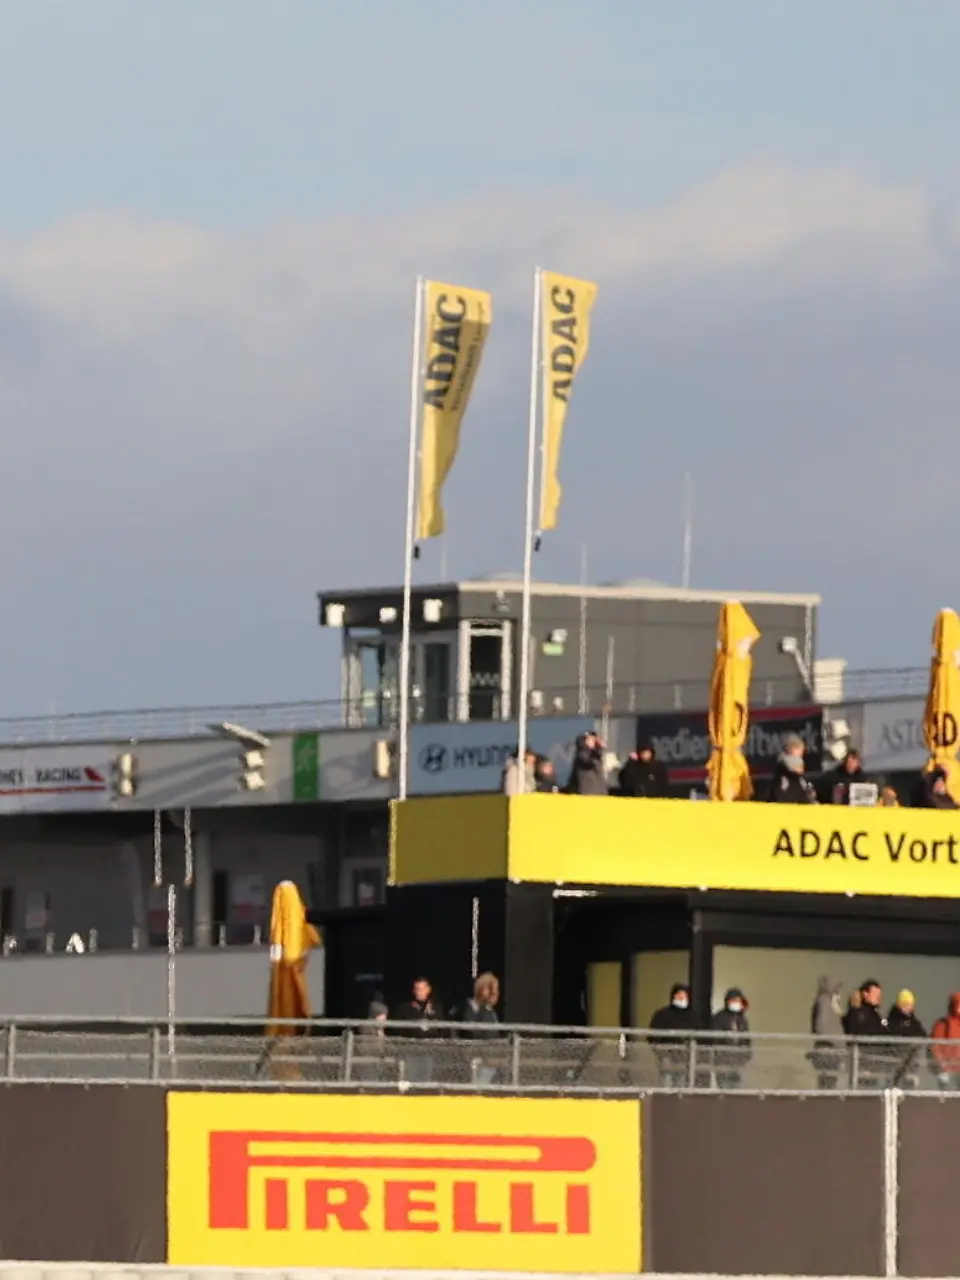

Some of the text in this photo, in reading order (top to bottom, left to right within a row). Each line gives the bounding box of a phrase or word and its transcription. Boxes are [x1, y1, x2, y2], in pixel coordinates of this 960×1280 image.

[424, 293, 467, 411] ADAC
[550, 285, 577, 402] ADAC
[772, 828, 960, 865] ADAC Vort
[208, 1130, 597, 1235] PIRELLI
